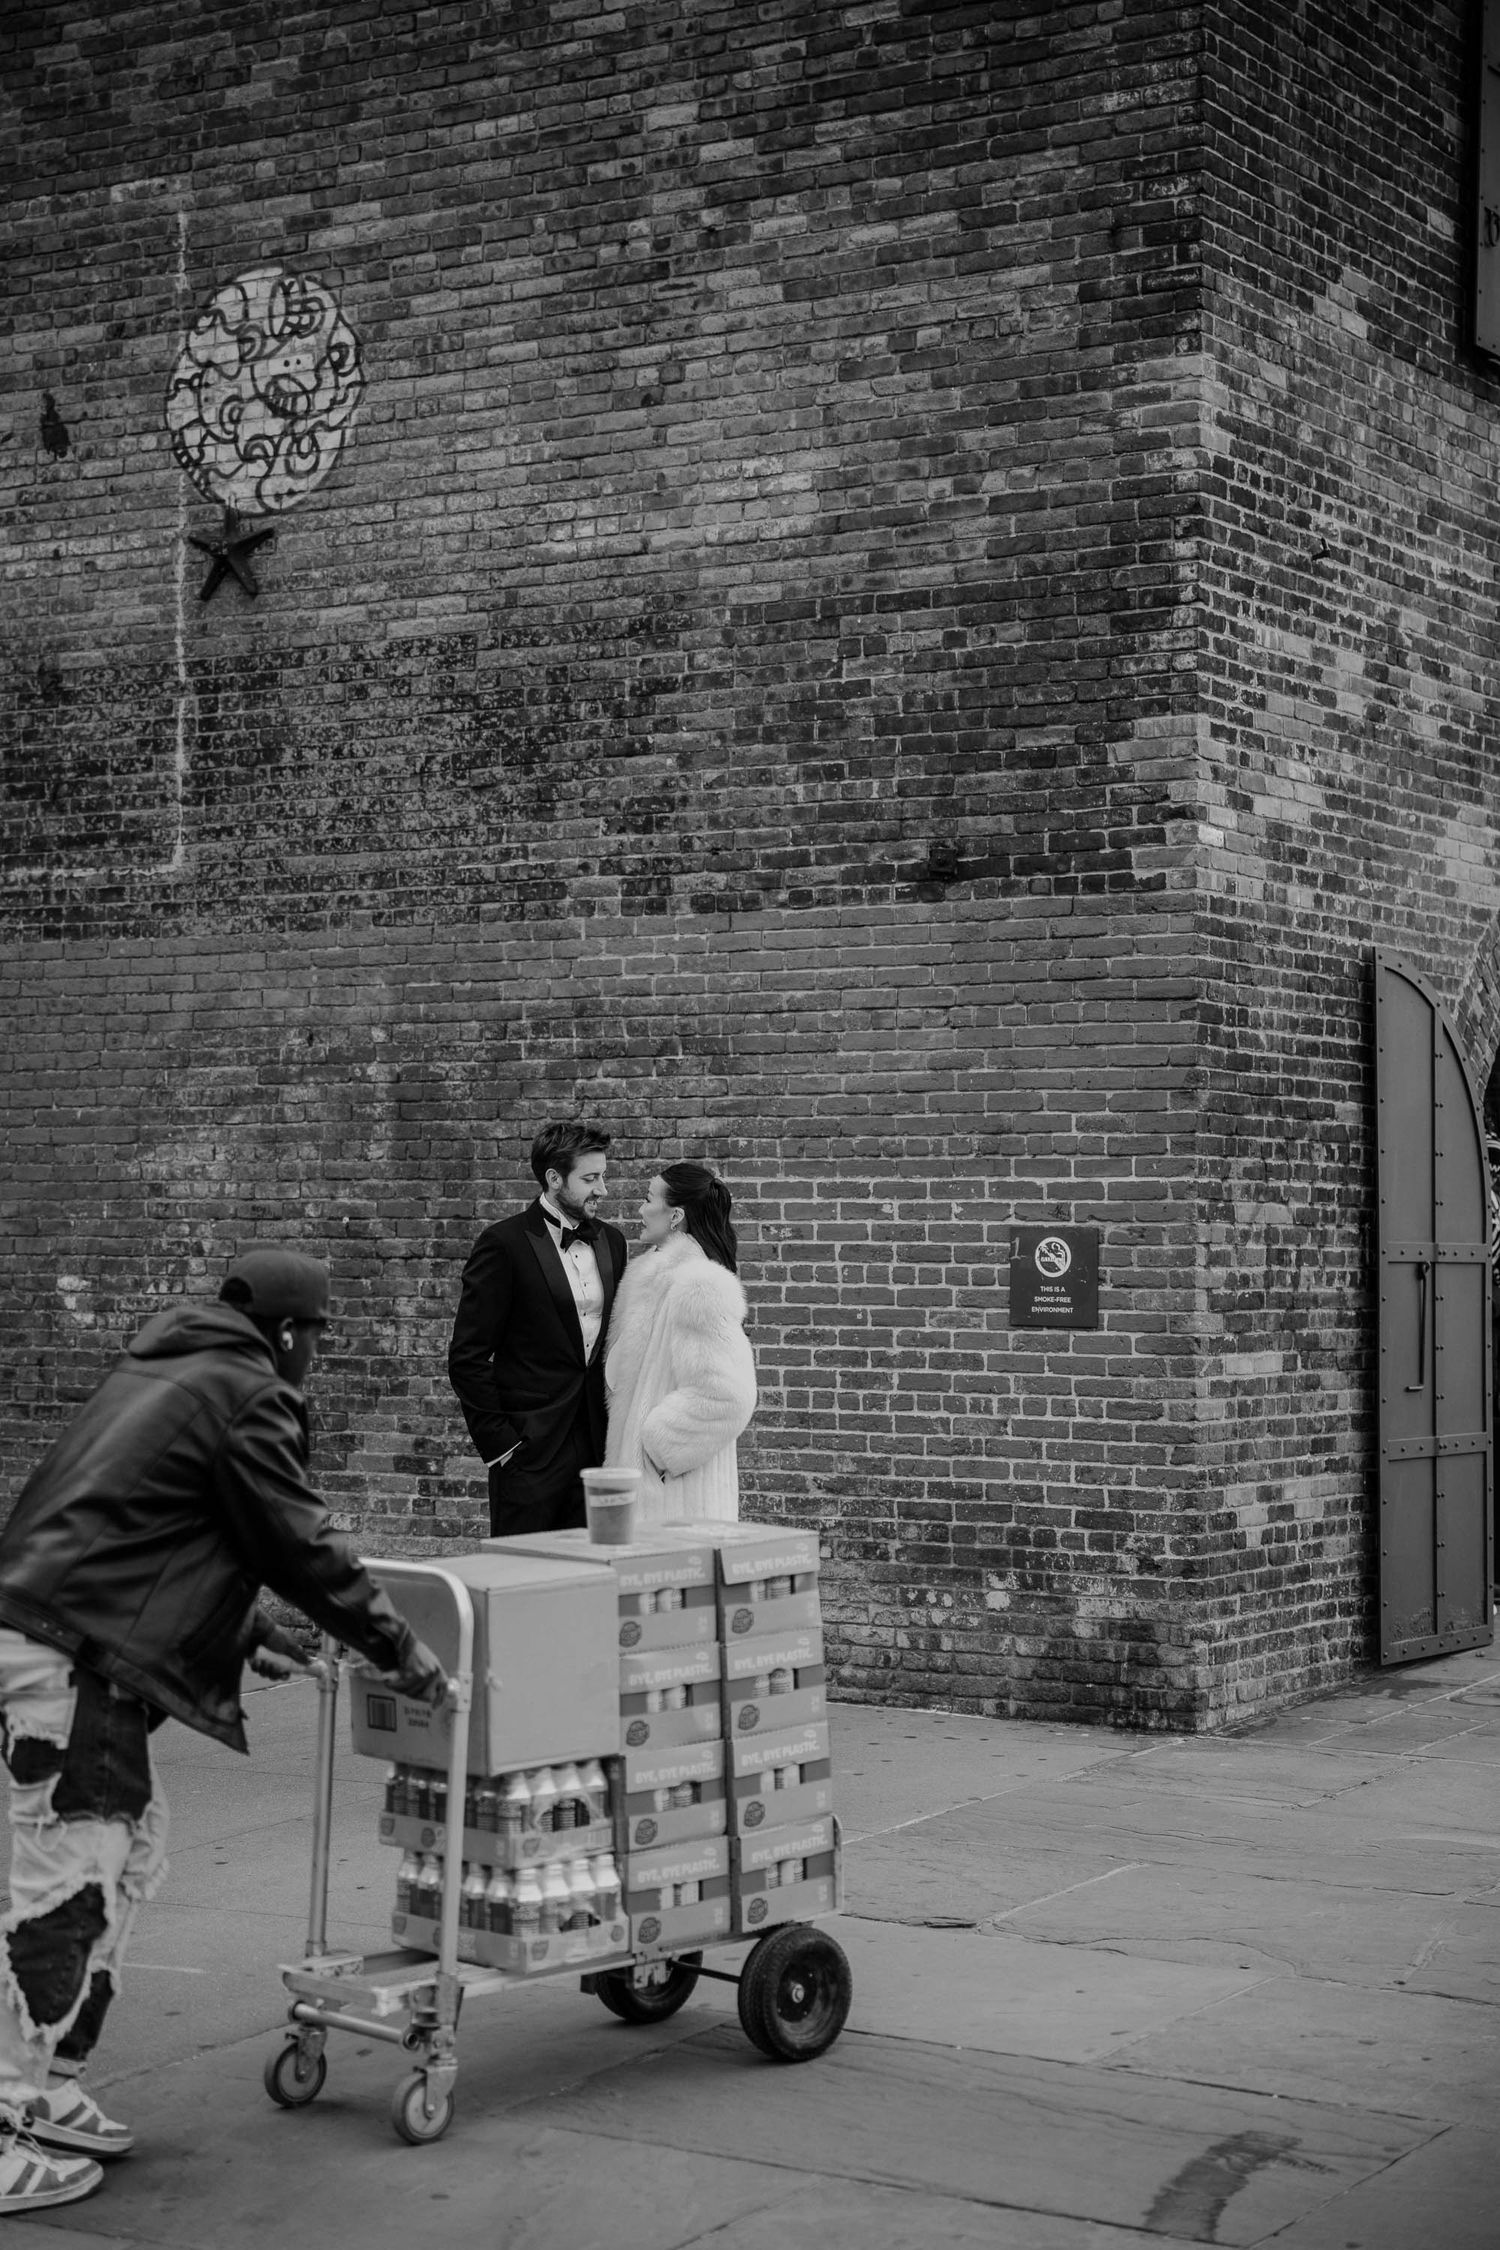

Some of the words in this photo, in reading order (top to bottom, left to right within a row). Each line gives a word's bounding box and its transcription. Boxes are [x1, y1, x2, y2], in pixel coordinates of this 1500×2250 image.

[1031, 1306, 1074, 1314] ENVIRONMENT
[755, 1559, 774, 1572] BYE
[643, 1571, 663, 1585] BYE
[756, 1653, 775, 1666] BYE
[654, 1668, 672, 1681] BYE
[763, 1748, 782, 1762] BYE
[659, 1766, 678, 1780] BYE
[774, 1844, 791, 1858] BYE
[662, 1864, 680, 1879] BYE
